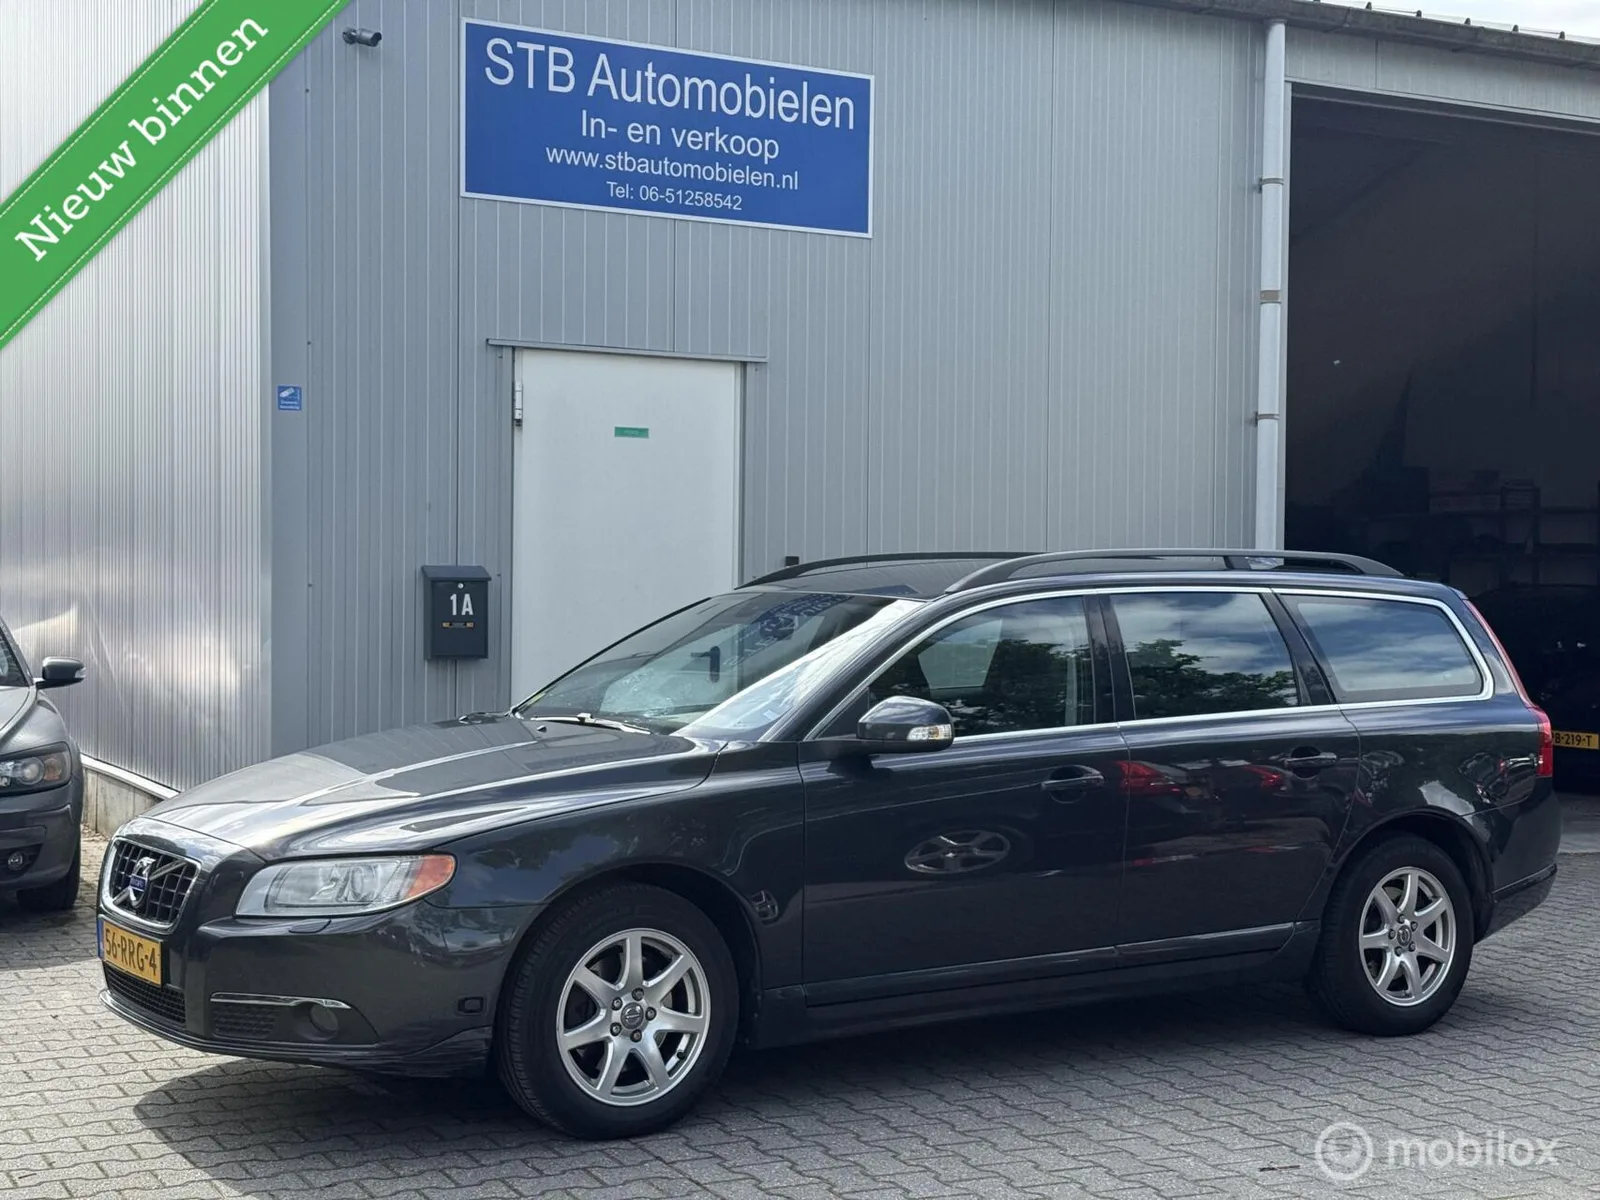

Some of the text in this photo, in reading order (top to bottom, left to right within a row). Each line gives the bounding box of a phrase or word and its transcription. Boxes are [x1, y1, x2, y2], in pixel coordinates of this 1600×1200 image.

[485, 37, 855, 130] STB Automobielen
[581, 109, 780, 164] In- en verkoop
[545, 146, 799, 191] www.stbautomobielen.nl
[606, 181, 743, 212] Tel: 06-51258542
[450, 593, 474, 616] 1A
[1552, 732, 1592, 747] B-219-T
[105, 928, 157, 976] 56-RRG-4
